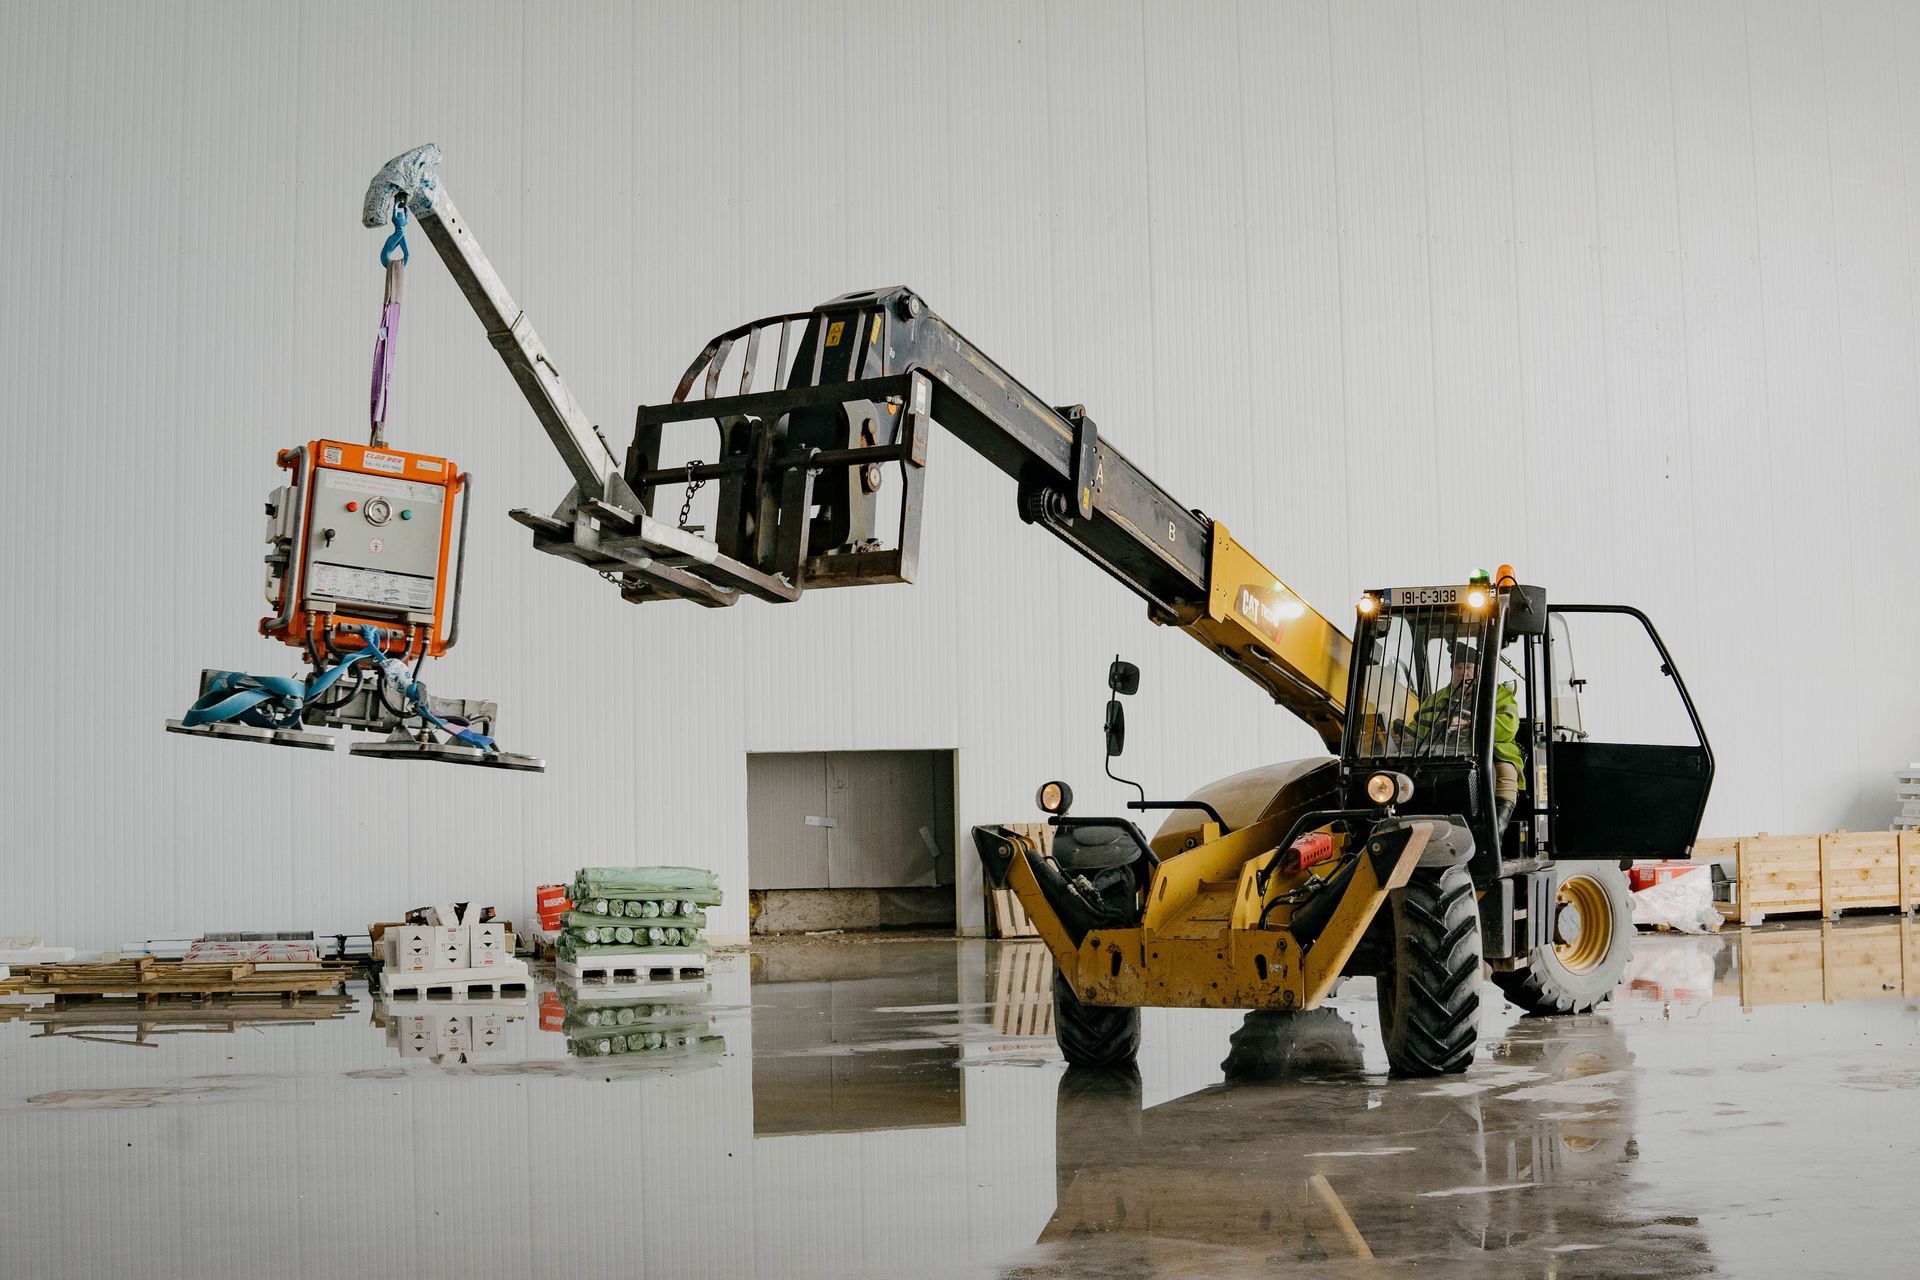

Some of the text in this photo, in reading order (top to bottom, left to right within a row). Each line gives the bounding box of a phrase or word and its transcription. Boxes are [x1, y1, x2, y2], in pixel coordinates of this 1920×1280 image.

[1096, 463, 1104, 485] A
[1168, 521, 1176, 542] B
[1242, 589, 1260, 625] CAT
[1401, 590, 1456, 604] 191-C-3138
